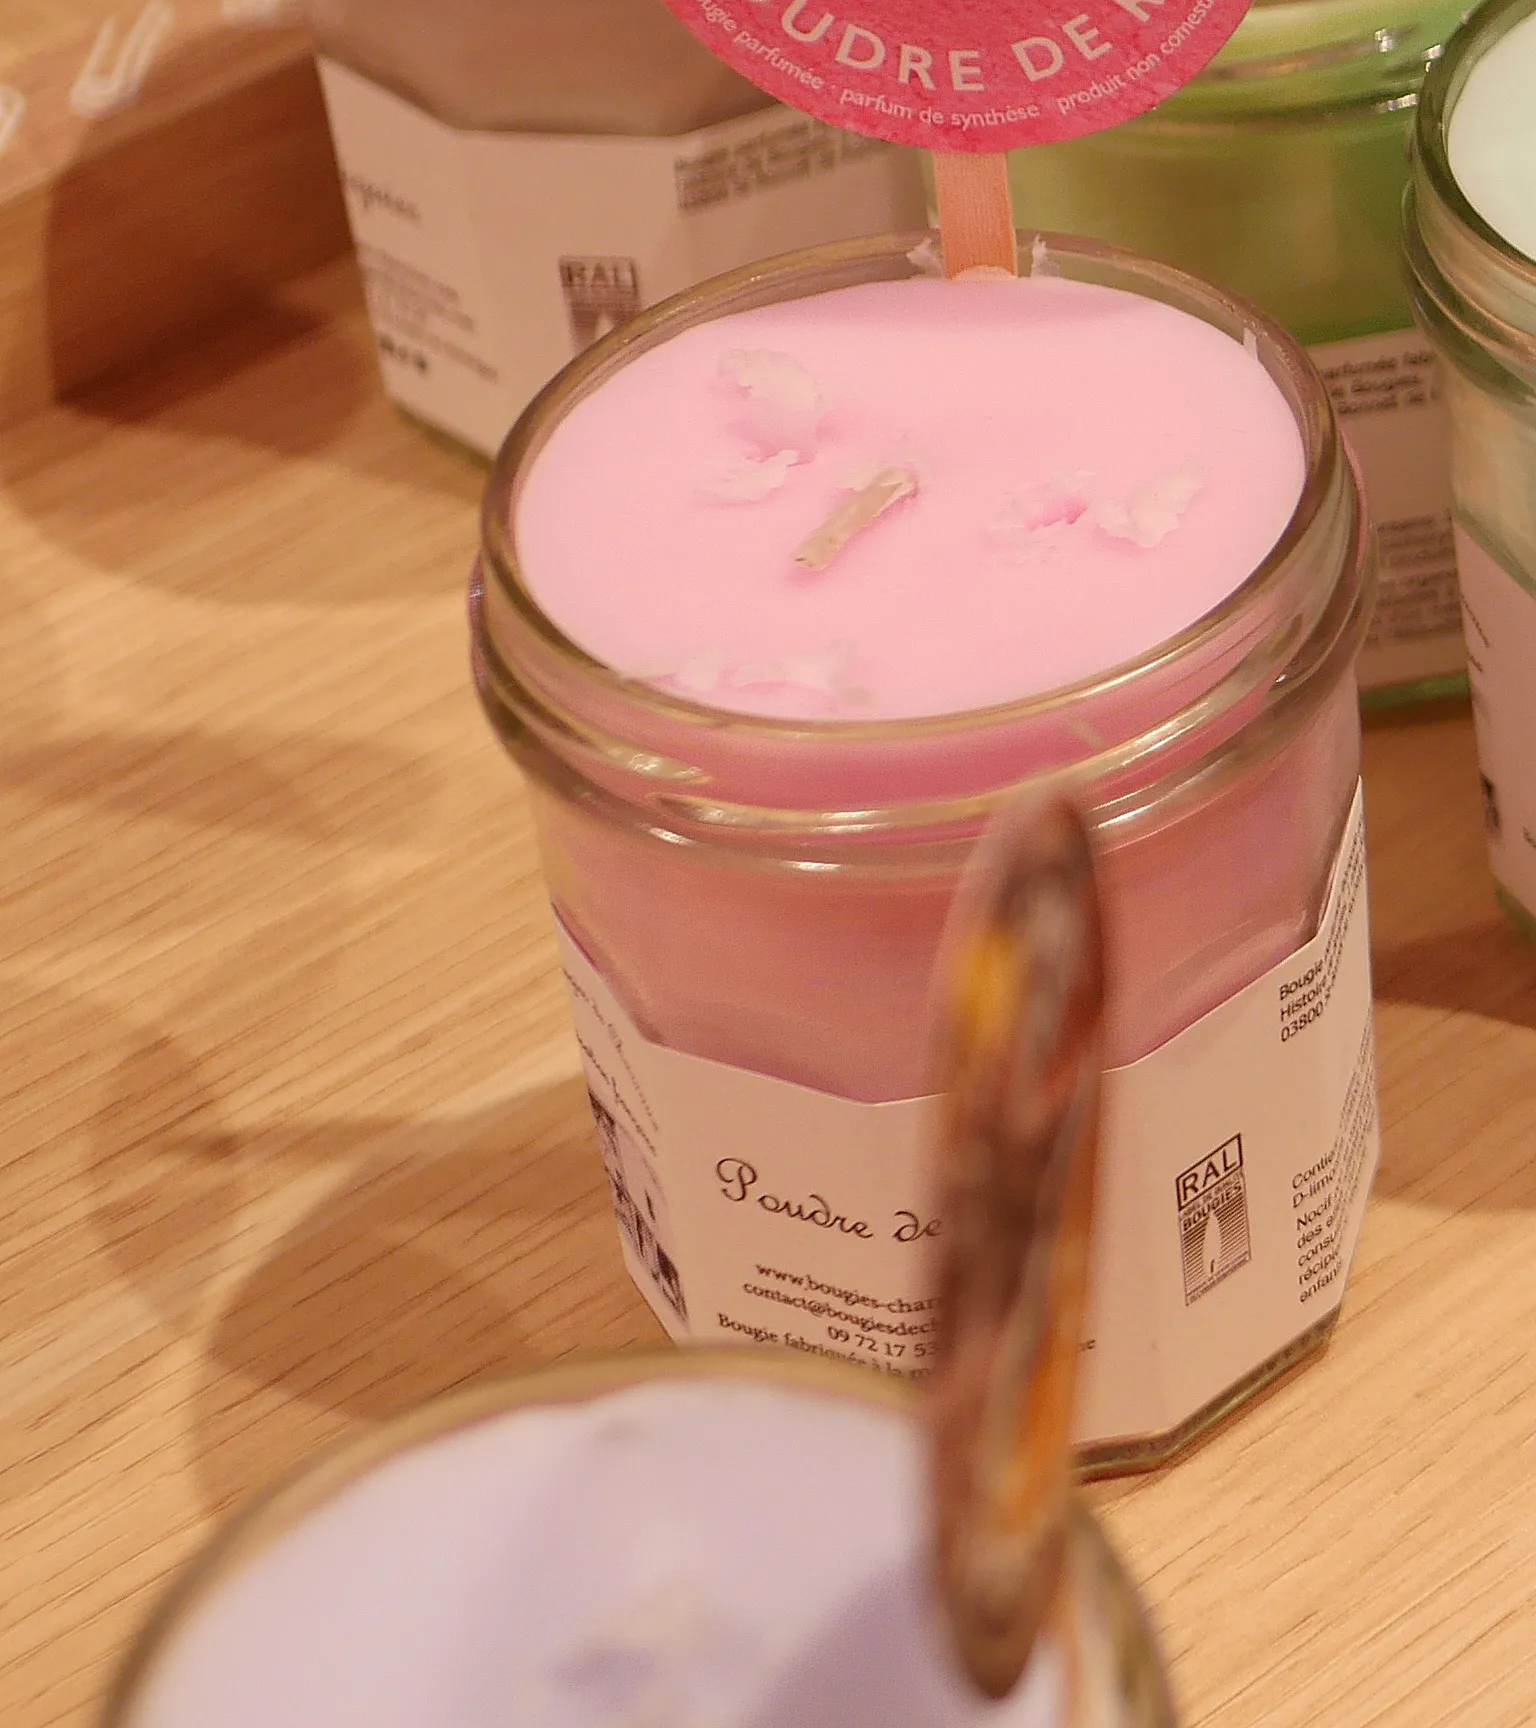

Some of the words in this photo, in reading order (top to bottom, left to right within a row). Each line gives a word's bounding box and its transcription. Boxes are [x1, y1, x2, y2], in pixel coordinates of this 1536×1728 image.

[1011, 14, 1113, 82] DE
[734, 29, 825, 90] parfumée
[840, 87, 912, 120] parfum
[919, 106, 944, 125] de
[950, 103, 1040, 132] synthèse
[1056, 75, 1126, 116] produit
[1125, 53, 1161, 81] non
[1281, 1003, 1324, 1042] 03800
[1181, 1148, 1238, 1204] RAL
[1292, 1148, 1336, 1190] Contie
[716, 1157, 875, 1240] Poudre
[893, 1210, 945, 1242] de
[1182, 1183, 1243, 1232] BOUGIES
[1297, 1226, 1323, 1251] des
[742, 1281, 938, 1337] contact@bougiesdec
[756, 1263, 942, 1314] www.bougies-char
[717, 1311, 779, 1344] Bougie
[826, 1324, 850, 1344] 09
[855, 1333, 878, 1352] 72
[884, 1341, 906, 1358] 17
